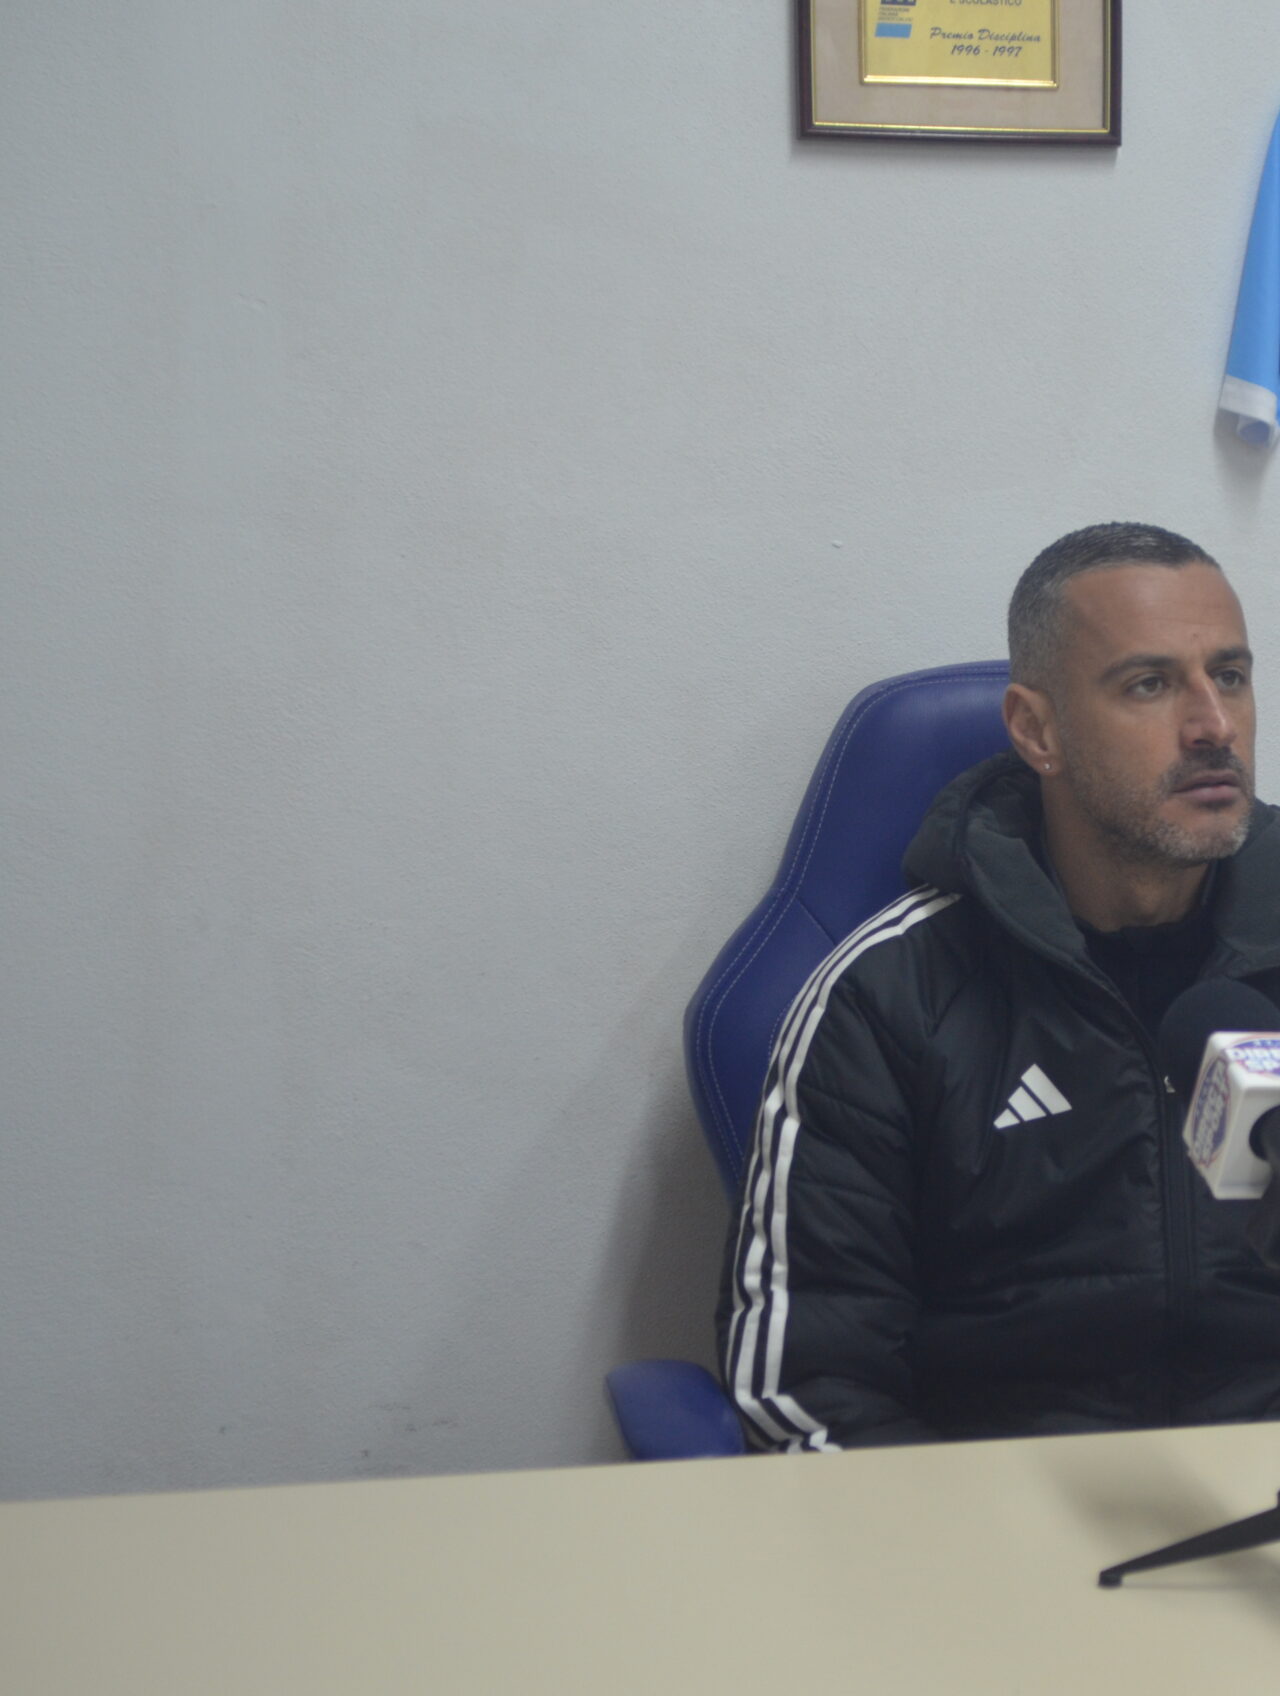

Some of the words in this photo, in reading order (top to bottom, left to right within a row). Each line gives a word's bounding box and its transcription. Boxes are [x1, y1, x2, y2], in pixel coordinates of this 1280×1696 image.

[929, 26, 974, 40] Premio
[978, 28, 1041, 44] Disciplina
[950, 44, 981, 56] 1996
[993, 45, 1023, 57] 1997
